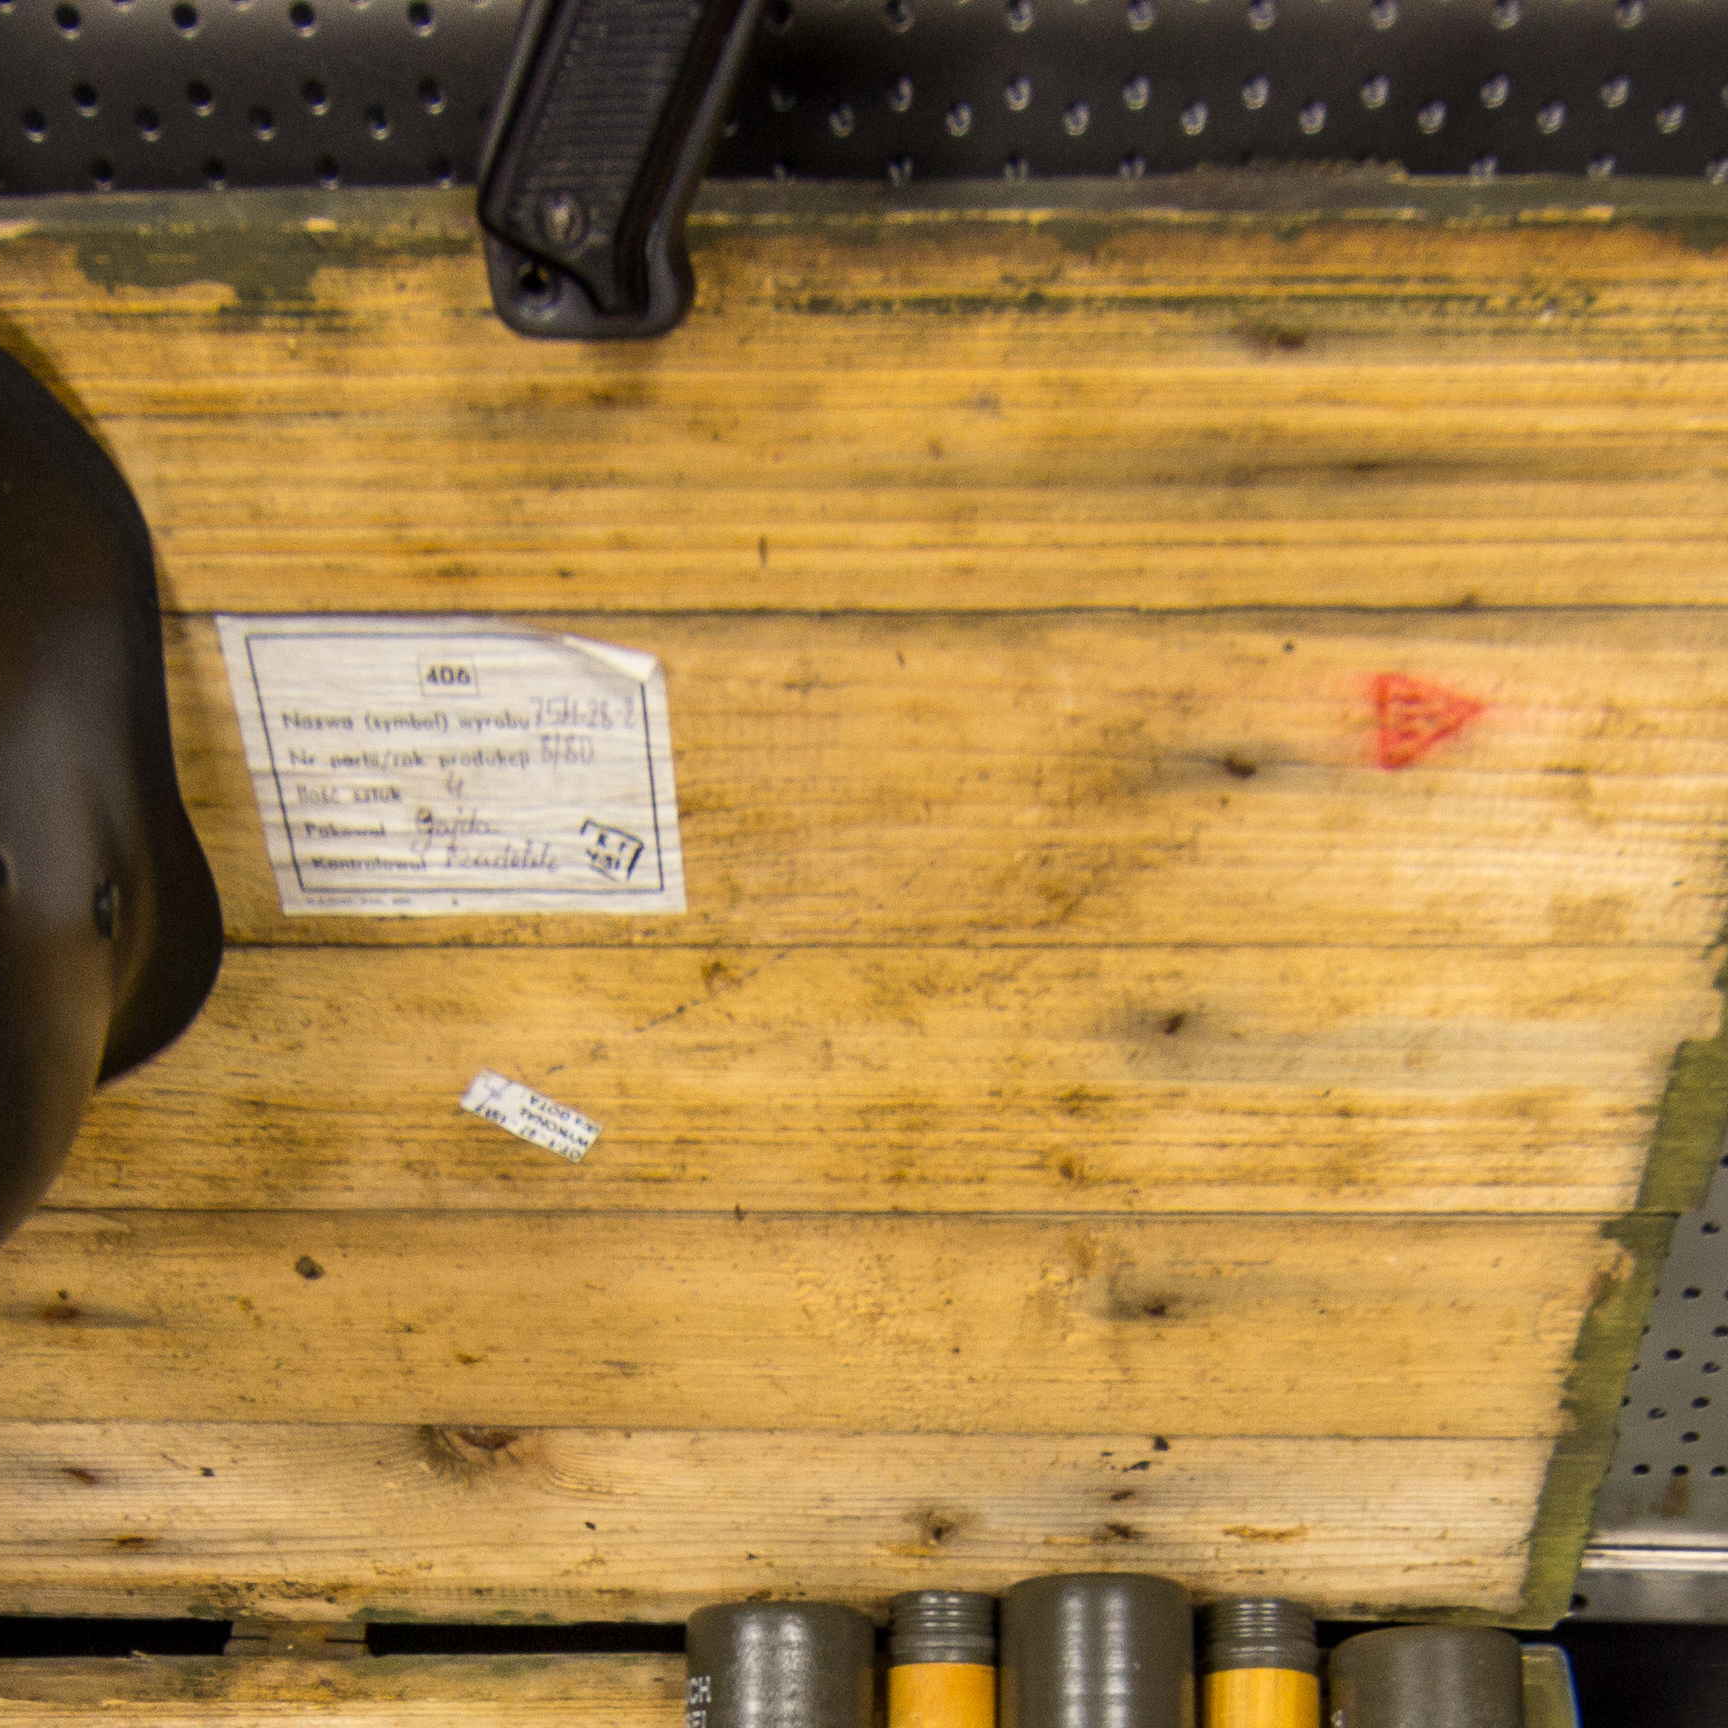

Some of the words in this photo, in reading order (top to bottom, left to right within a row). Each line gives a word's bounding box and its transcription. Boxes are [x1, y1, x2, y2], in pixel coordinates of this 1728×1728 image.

[364, 710, 449, 733] (symbol)
[458, 709, 531, 734] wyrobu
[288, 747, 315, 768] Nr
